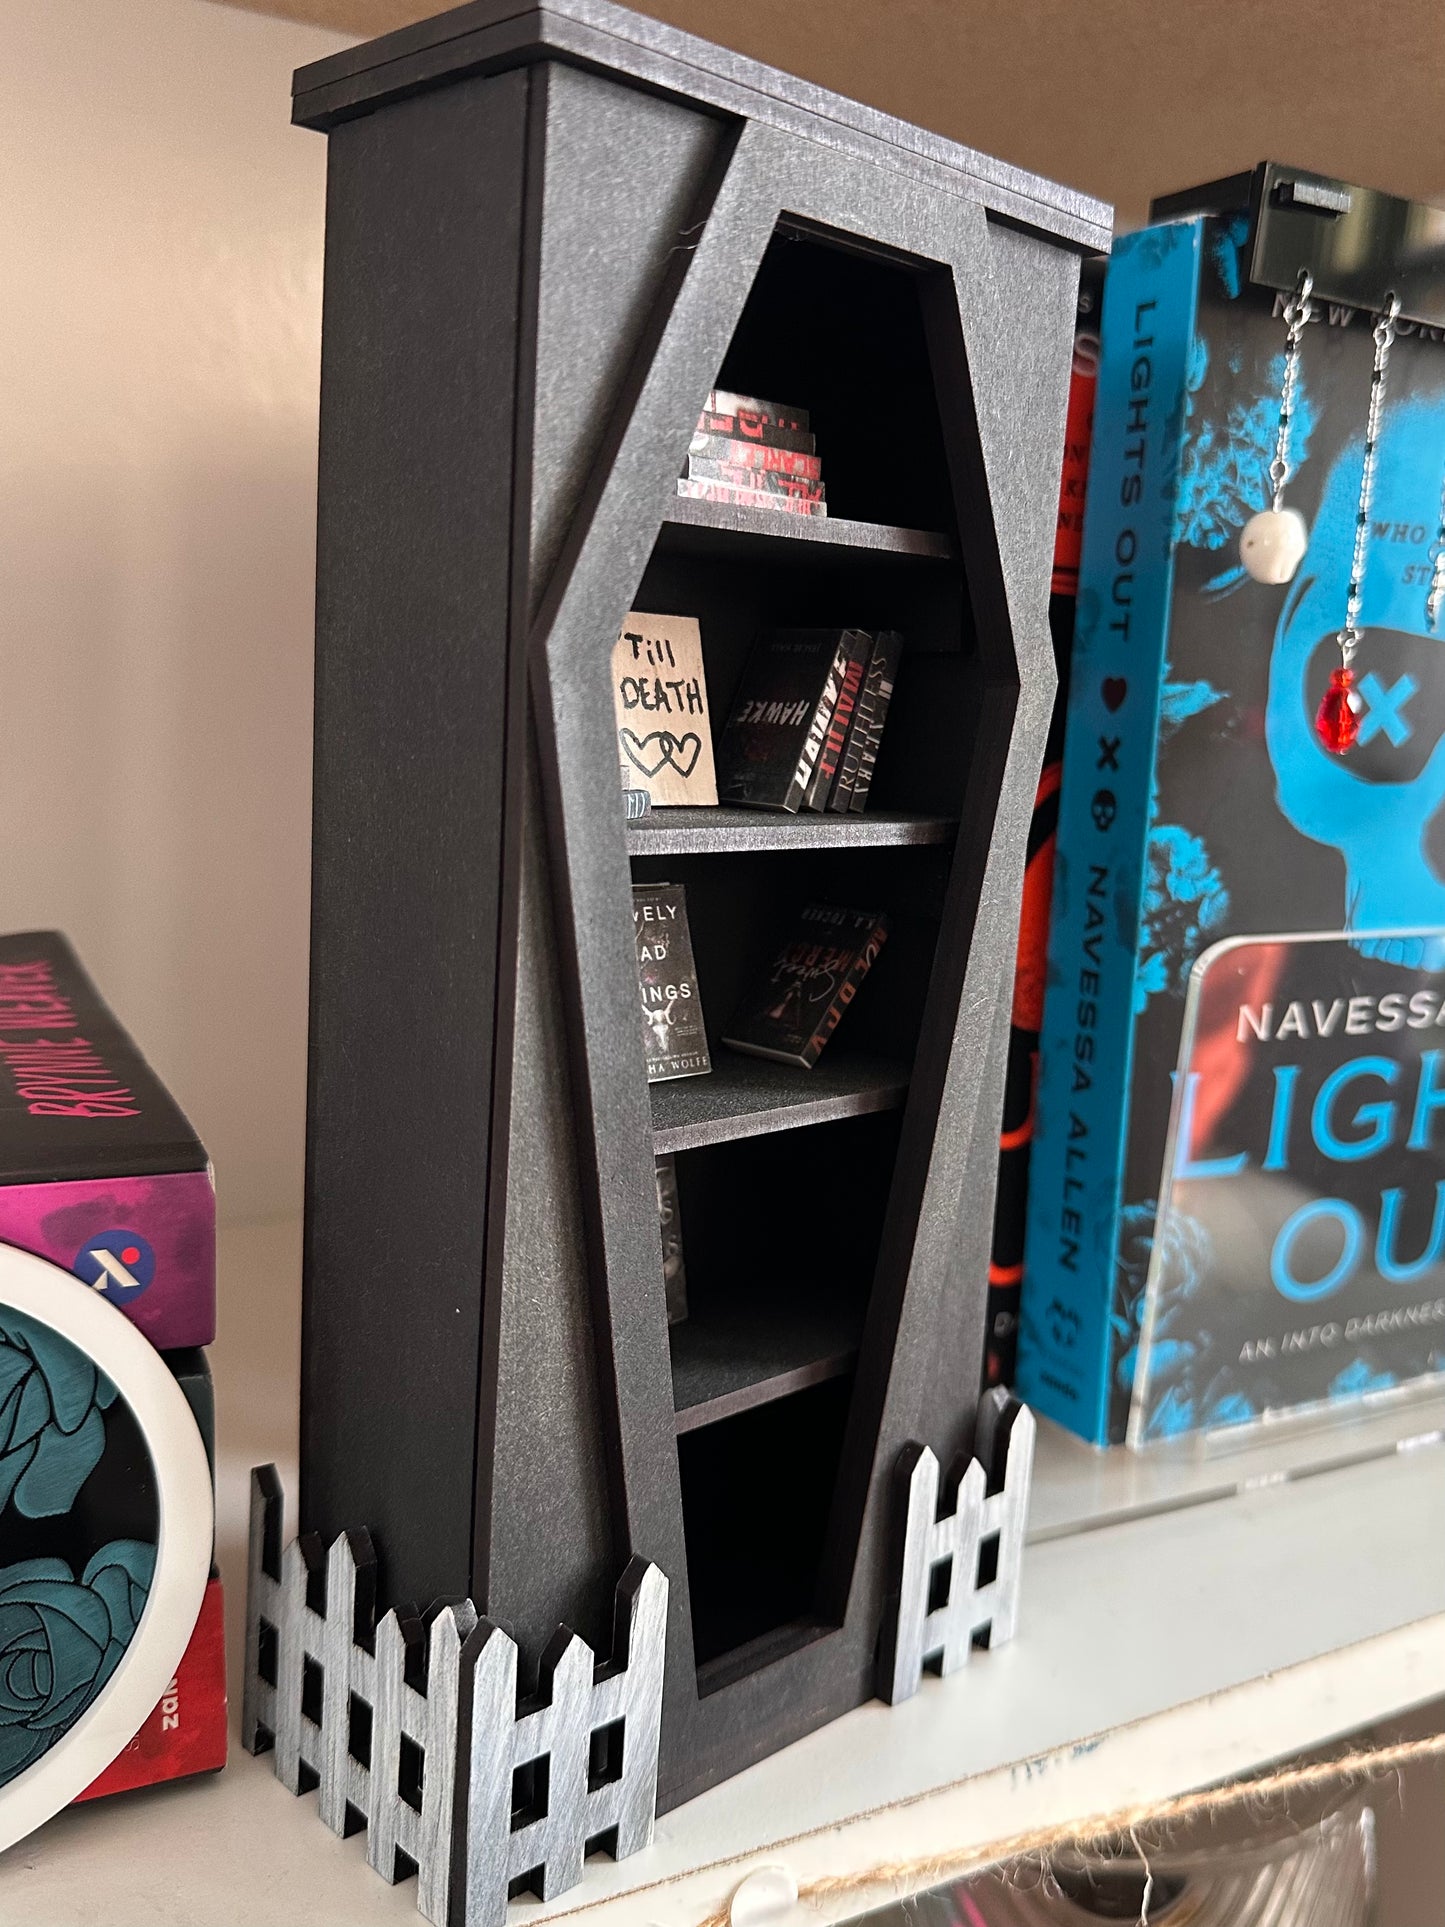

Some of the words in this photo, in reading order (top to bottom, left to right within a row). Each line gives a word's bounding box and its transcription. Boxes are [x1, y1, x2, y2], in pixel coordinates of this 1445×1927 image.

[1121, 299, 1157, 508] LIGHTS
[1371, 521, 1426, 544] WHO
[1108, 528, 1137, 643] OUT
[620, 677, 703, 714] DEATH
[738, 700, 810, 725] HAWKE
[839, 658, 886, 791] RUTHLESS
[1070, 864, 1109, 1093] NAVESSA
[672, 1057, 709, 1070] WOLFE
[1058, 1111, 1088, 1274] ALLEN
[1281, 1321, 1343, 1352] INTO
